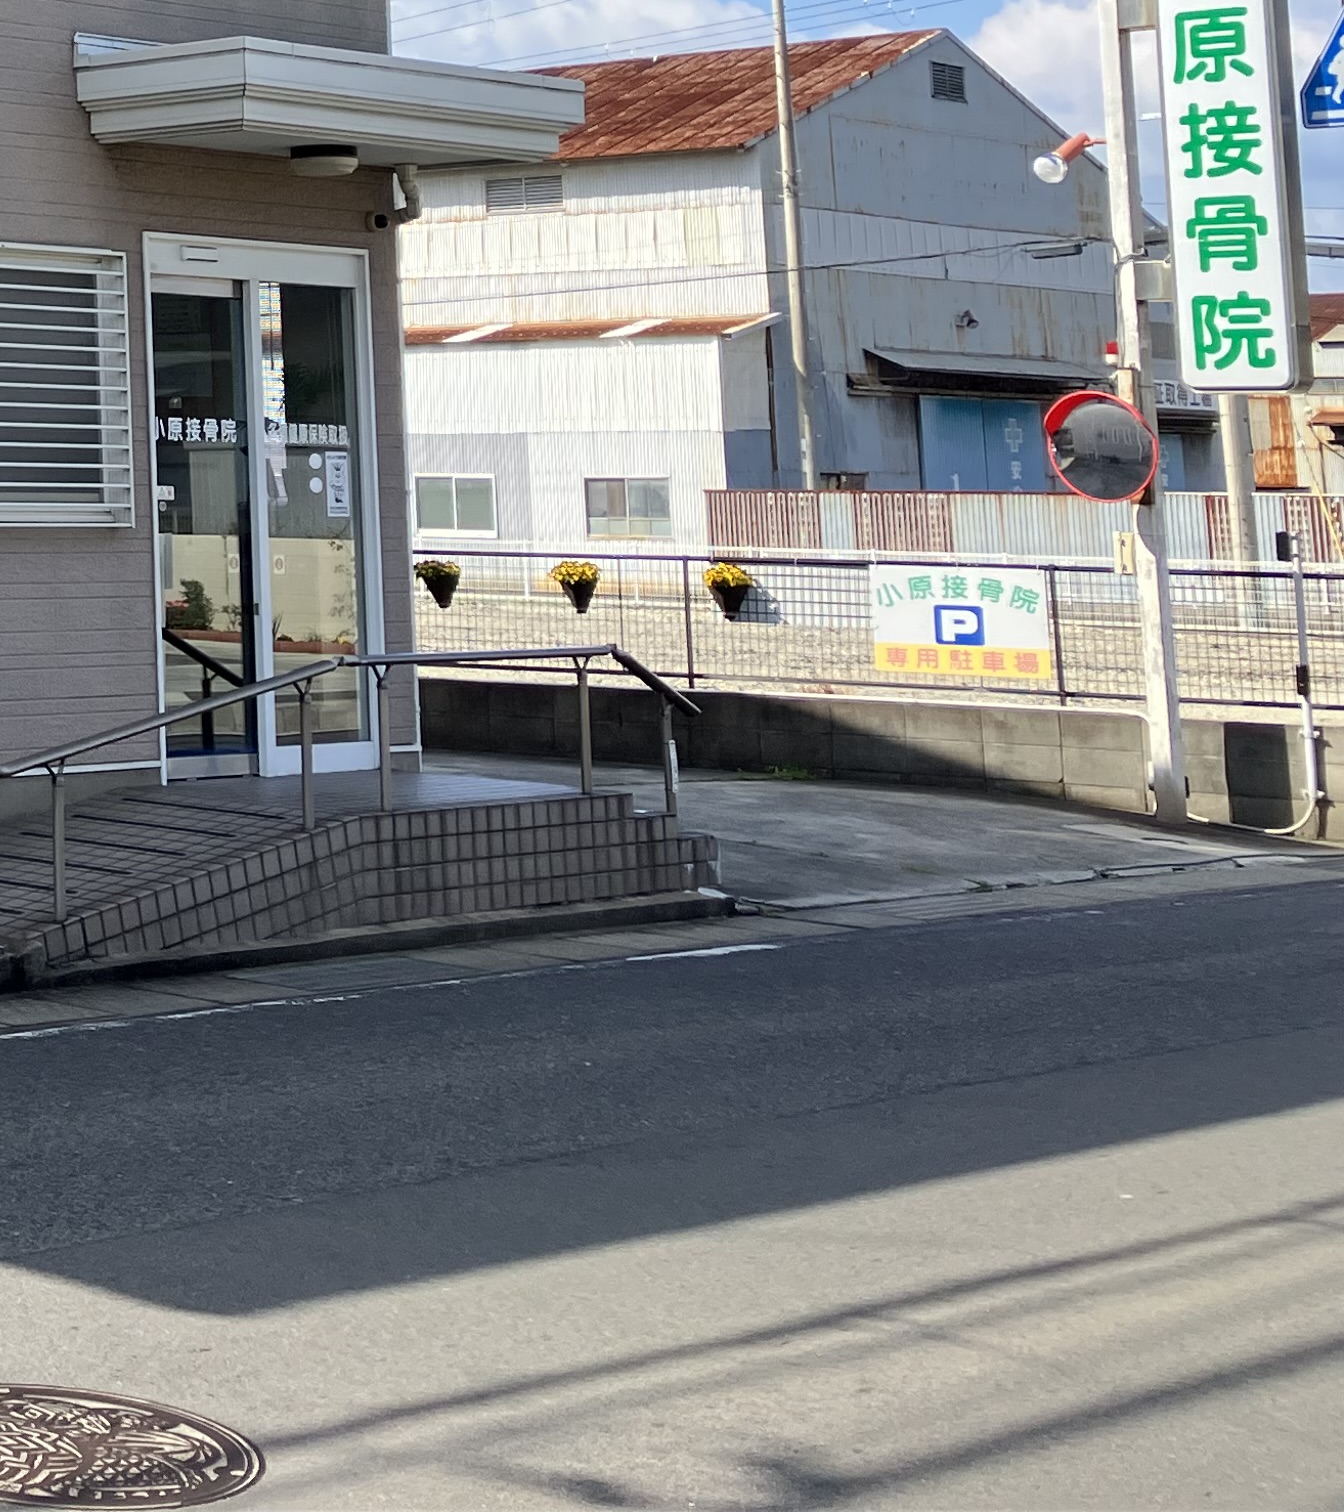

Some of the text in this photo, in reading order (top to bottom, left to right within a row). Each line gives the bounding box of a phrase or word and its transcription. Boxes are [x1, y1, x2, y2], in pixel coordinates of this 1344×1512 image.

[876, 575, 1040, 614] 小原接骨院
[887, 648, 1038, 672] 専用駐車場
